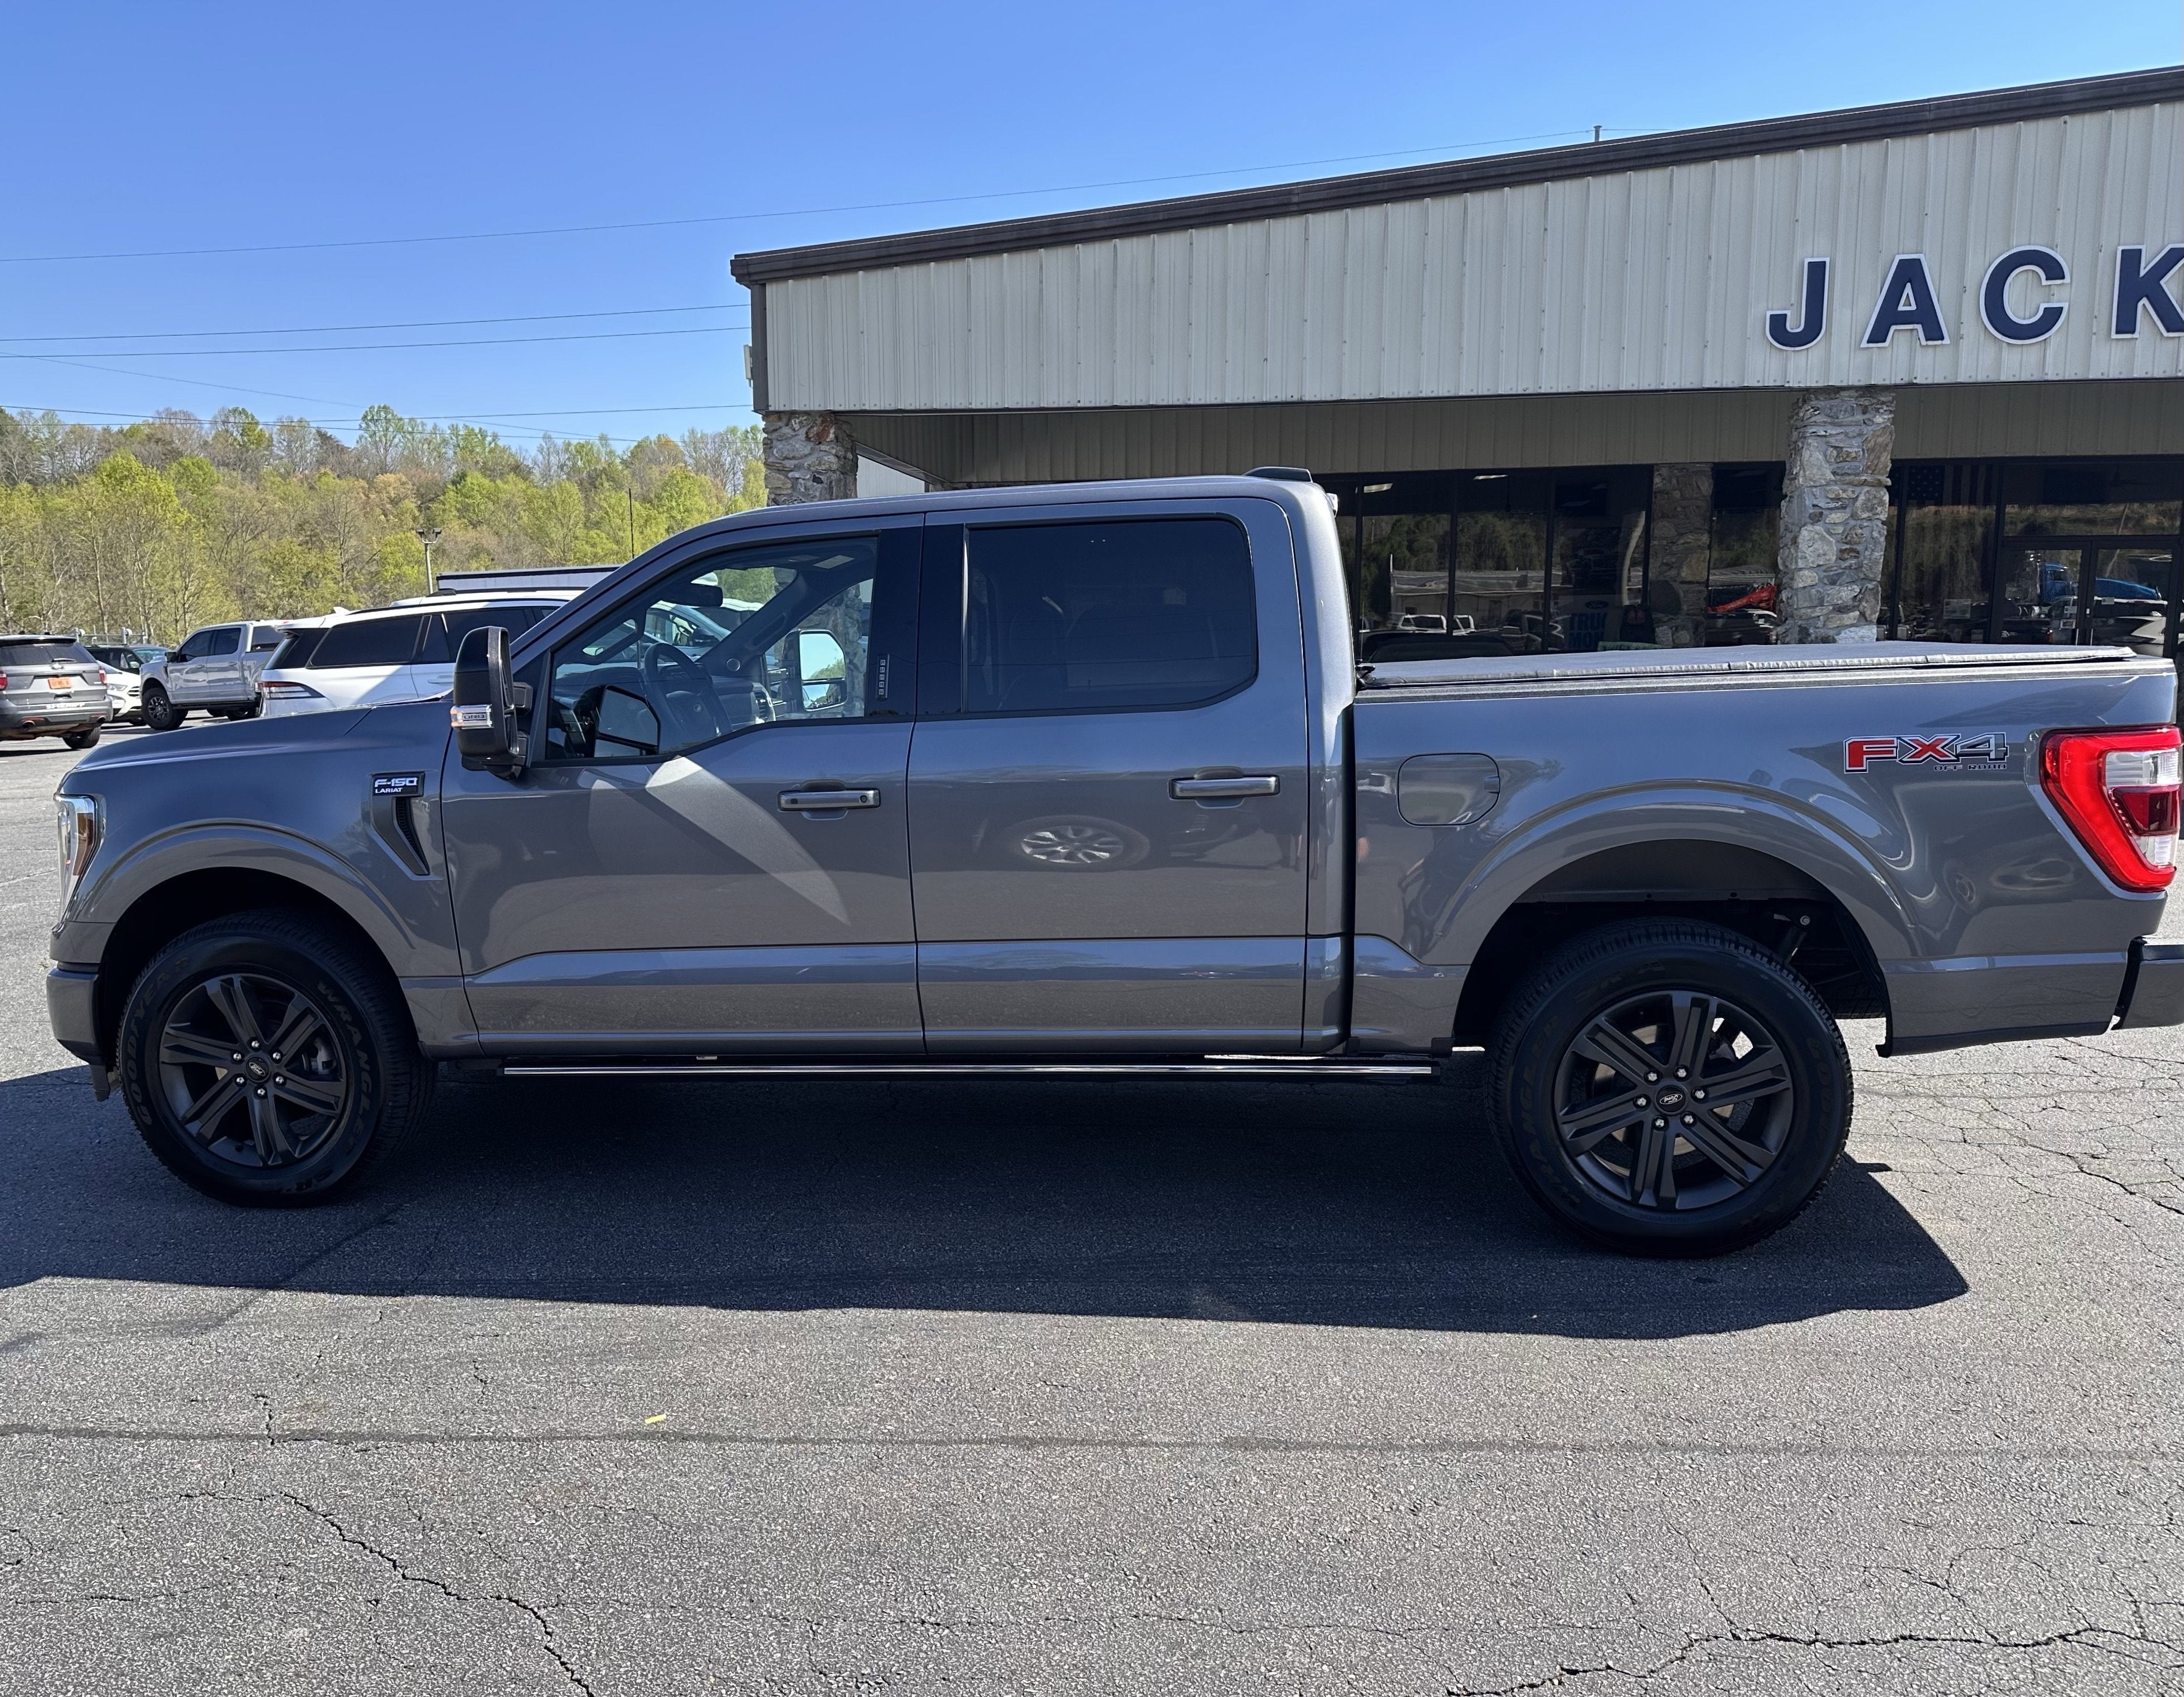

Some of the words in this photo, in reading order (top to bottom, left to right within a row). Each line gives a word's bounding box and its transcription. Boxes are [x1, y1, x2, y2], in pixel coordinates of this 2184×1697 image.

[1766, 244, 2184, 351] JACK
[1844, 732, 2009, 774] FX4
[375, 777, 418, 787] F-150
[127, 957, 189, 1125] GOODYEAR
[1662, 1094, 1680, 1104] Ford
